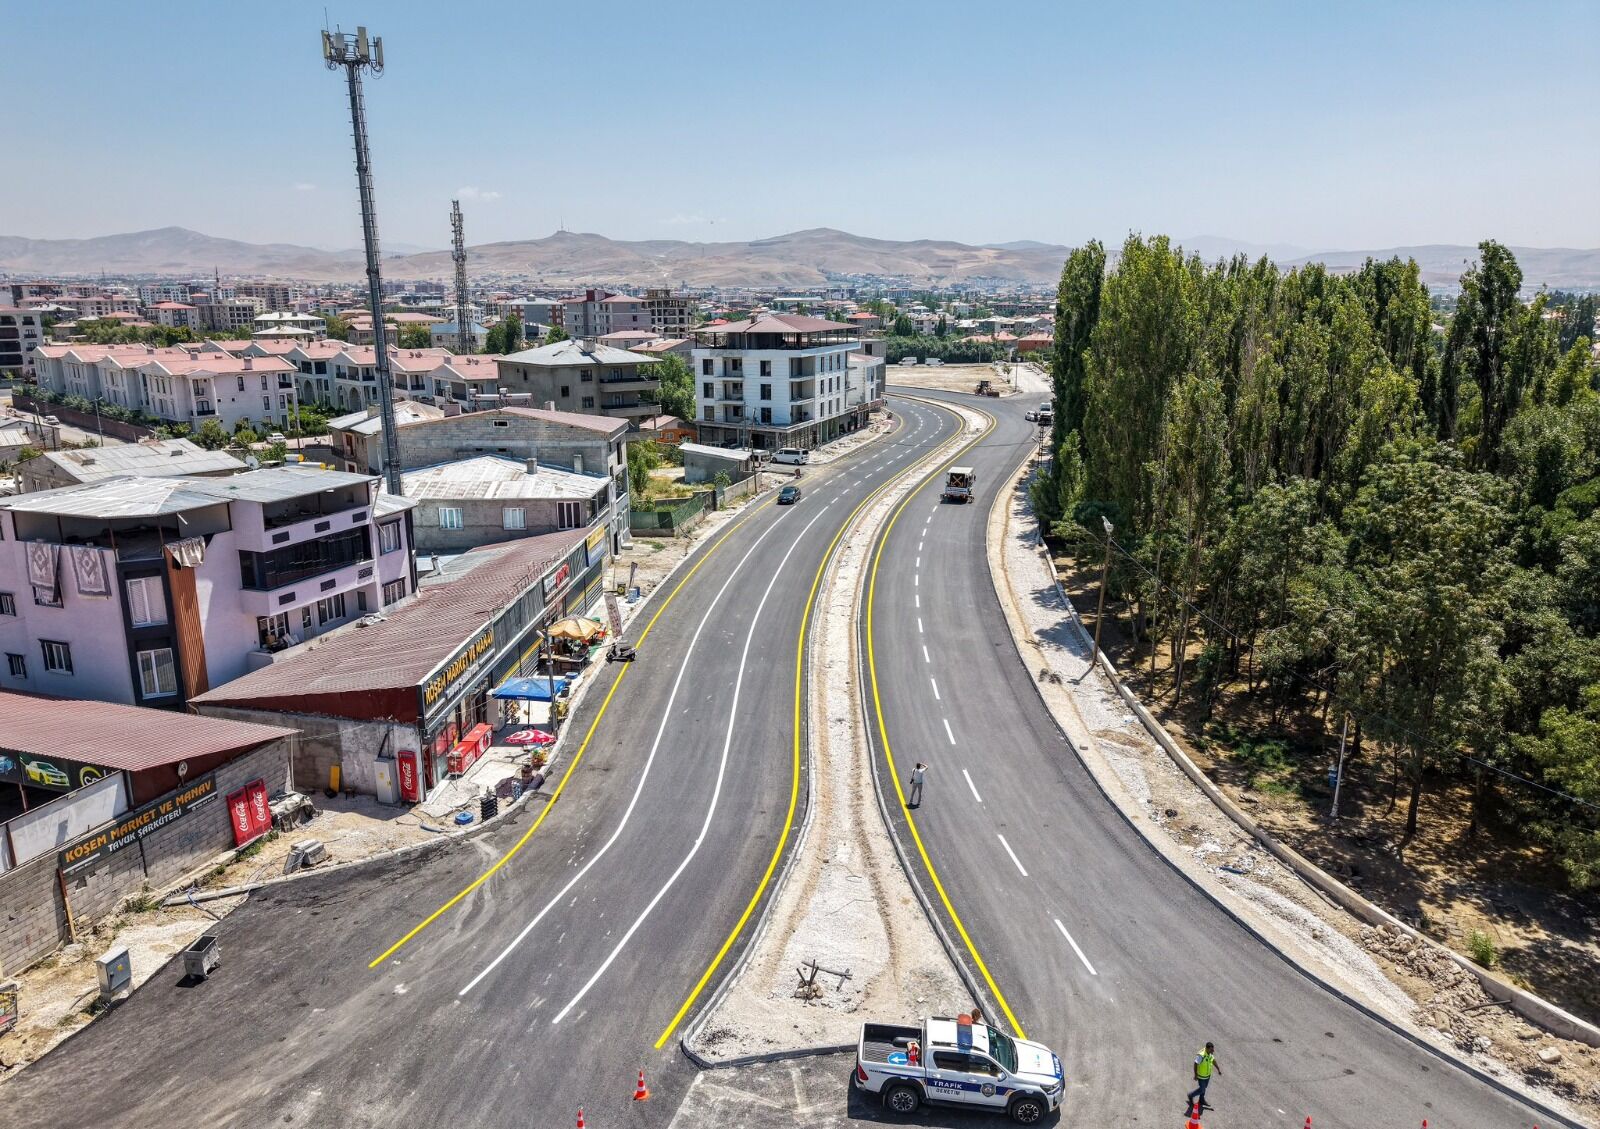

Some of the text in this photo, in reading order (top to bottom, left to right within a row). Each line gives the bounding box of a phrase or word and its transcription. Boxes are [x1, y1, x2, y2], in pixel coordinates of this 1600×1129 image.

[447, 651, 469, 683] MARKET
[65, 836, 107, 863] KÖŞEM
[110, 810, 157, 840] MARKET
[159, 801, 174, 815] VE
[176, 781, 211, 807] MANAV
[108, 807, 182, 852] TAVUK ŞARKÜTERİ
[933, 1080, 962, 1089] TRAFİK
